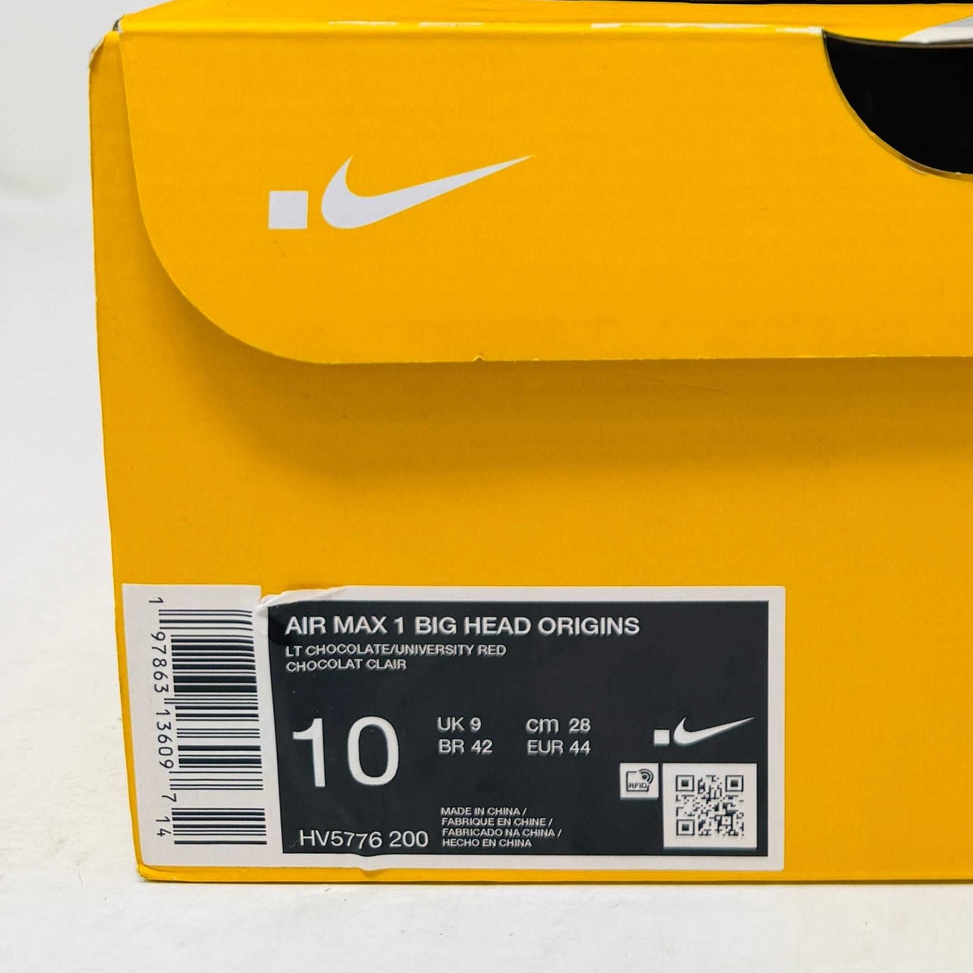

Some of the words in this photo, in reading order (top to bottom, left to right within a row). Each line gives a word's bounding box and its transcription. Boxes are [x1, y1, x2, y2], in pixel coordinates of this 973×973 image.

[285, 616, 327, 636] AIR
[333, 616, 388, 635] MAX
[393, 616, 405, 635] 1
[415, 616, 457, 636] BIG
[464, 616, 532, 636] HEAD
[537, 616, 641, 636] ORIGINS
[285, 645, 303, 658] LT
[305, 643, 475, 657] CHOCOLATE/UNIVERSITY
[477, 644, 507, 657] RED
[150, 631, 170, 693] 97863
[285, 658, 363, 672] CHOCOLAT
[365, 658, 407, 671] CLAIR
[437, 717, 465, 732] UK
[469, 717, 482, 732] 9
[525, 718, 560, 734] cm
[568, 718, 592, 733] 28
[155, 709, 175, 769] 13609
[438, 739, 465, 755] BR
[471, 739, 494, 755] 42
[292, 715, 400, 788] 10
[527, 740, 564, 756] EUR
[568, 740, 592, 756] 44
[161, 793, 177, 802] 7
[440, 807, 473, 816] MADE
[474, 807, 485, 816] IN
[487, 807, 521, 816] CHINA
[155, 816, 172, 837] 14
[441, 817, 495, 827] FABRIQUE
[497, 817, 512, 827] EN
[514, 817, 547, 827] CHINE
[299, 829, 383, 849] HV5776
[389, 830, 430, 848] 200
[441, 828, 504, 838] FABRICADO
[505, 828, 521, 838] NA
[522, 828, 556, 838] CHINA
[442, 838, 480, 848] HECHO
[482, 838, 497, 848] EN
[499, 838, 533, 848] CHINA
